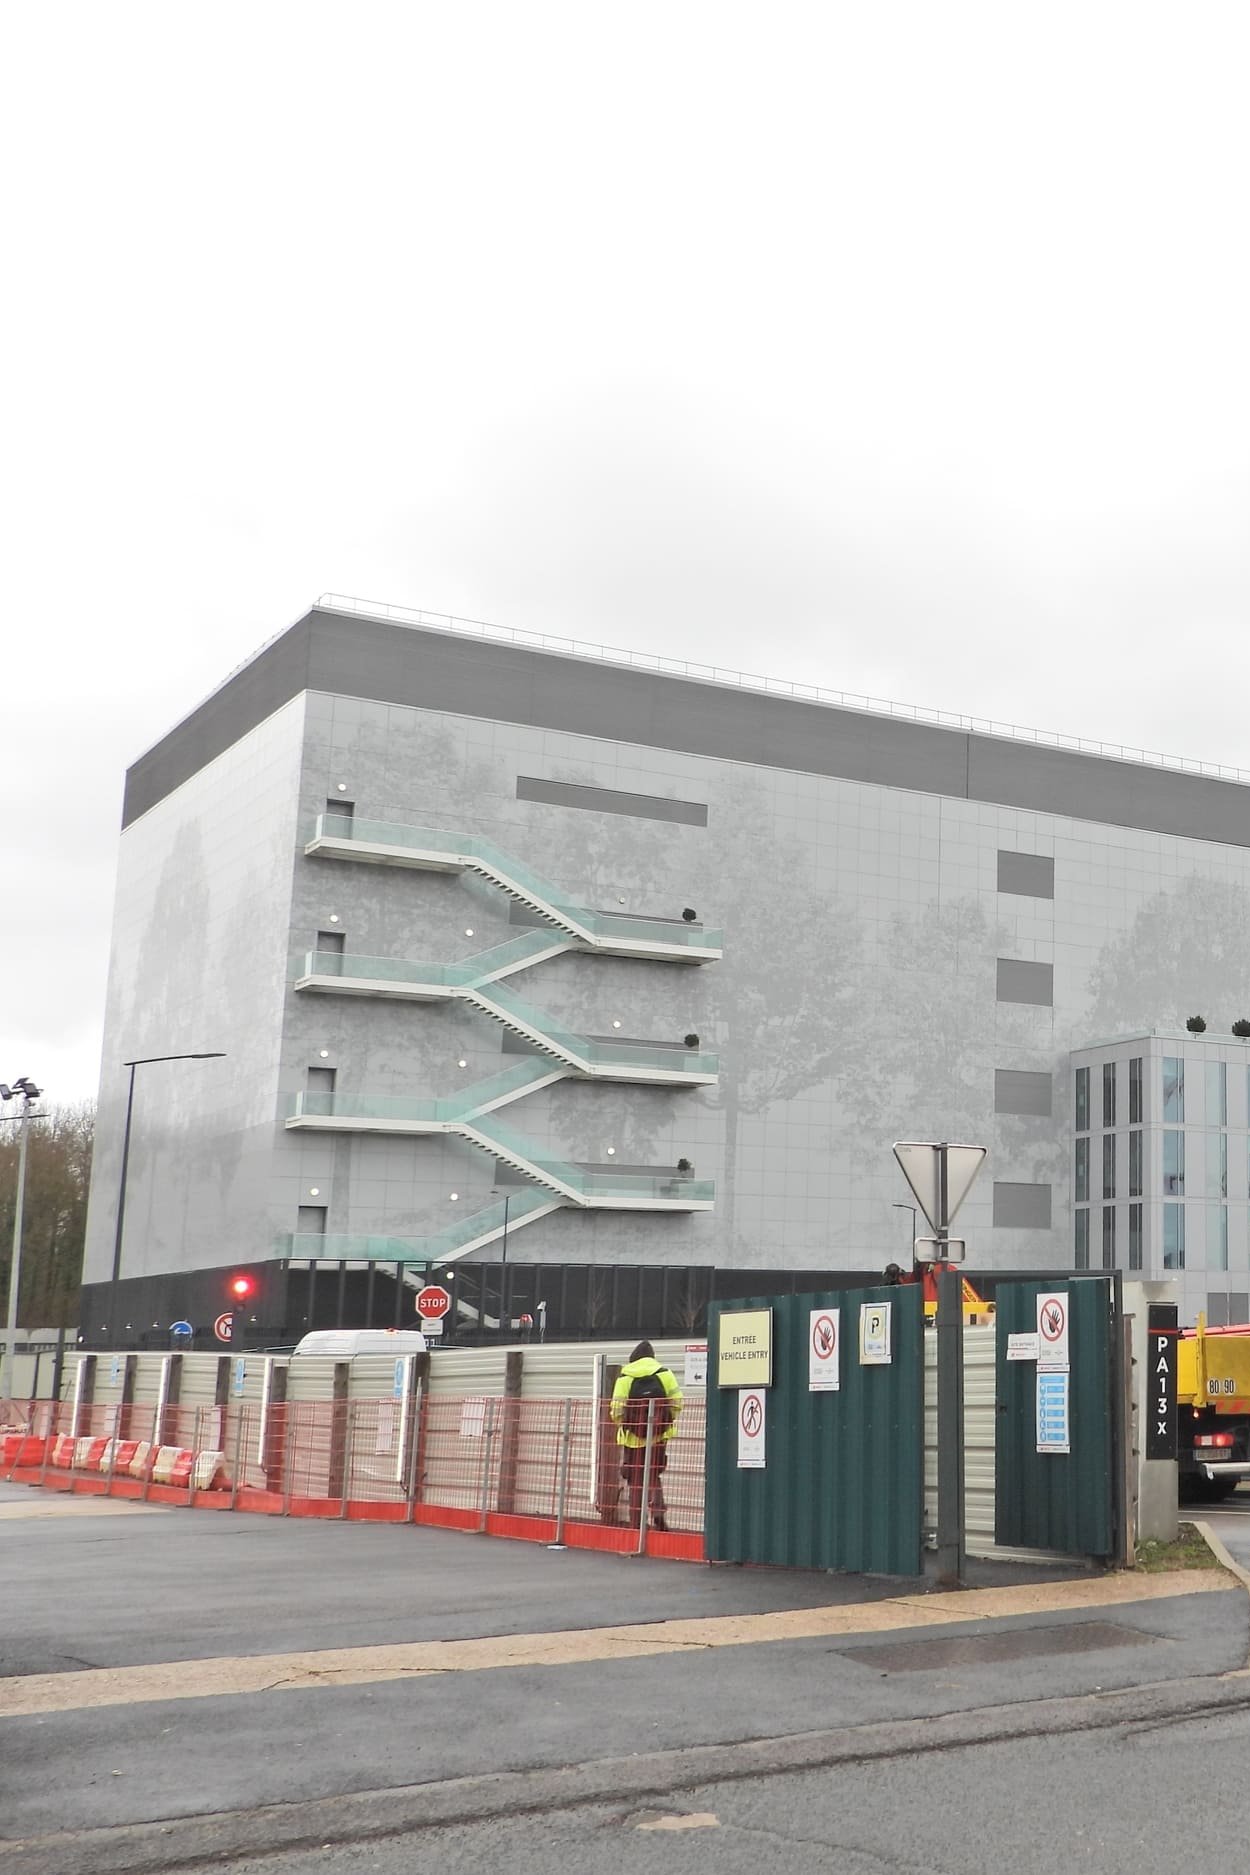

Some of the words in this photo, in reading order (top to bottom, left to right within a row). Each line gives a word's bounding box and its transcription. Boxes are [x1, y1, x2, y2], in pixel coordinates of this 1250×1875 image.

[420, 1298, 446, 1308] STOP
[733, 1336, 757, 1344] ENTREE
[721, 1352, 747, 1360] VEHICLE
[748, 1351, 769, 1360] ENTRY
[1209, 1380, 1219, 1394] 80
[1224, 1380, 1234, 1394] 90
